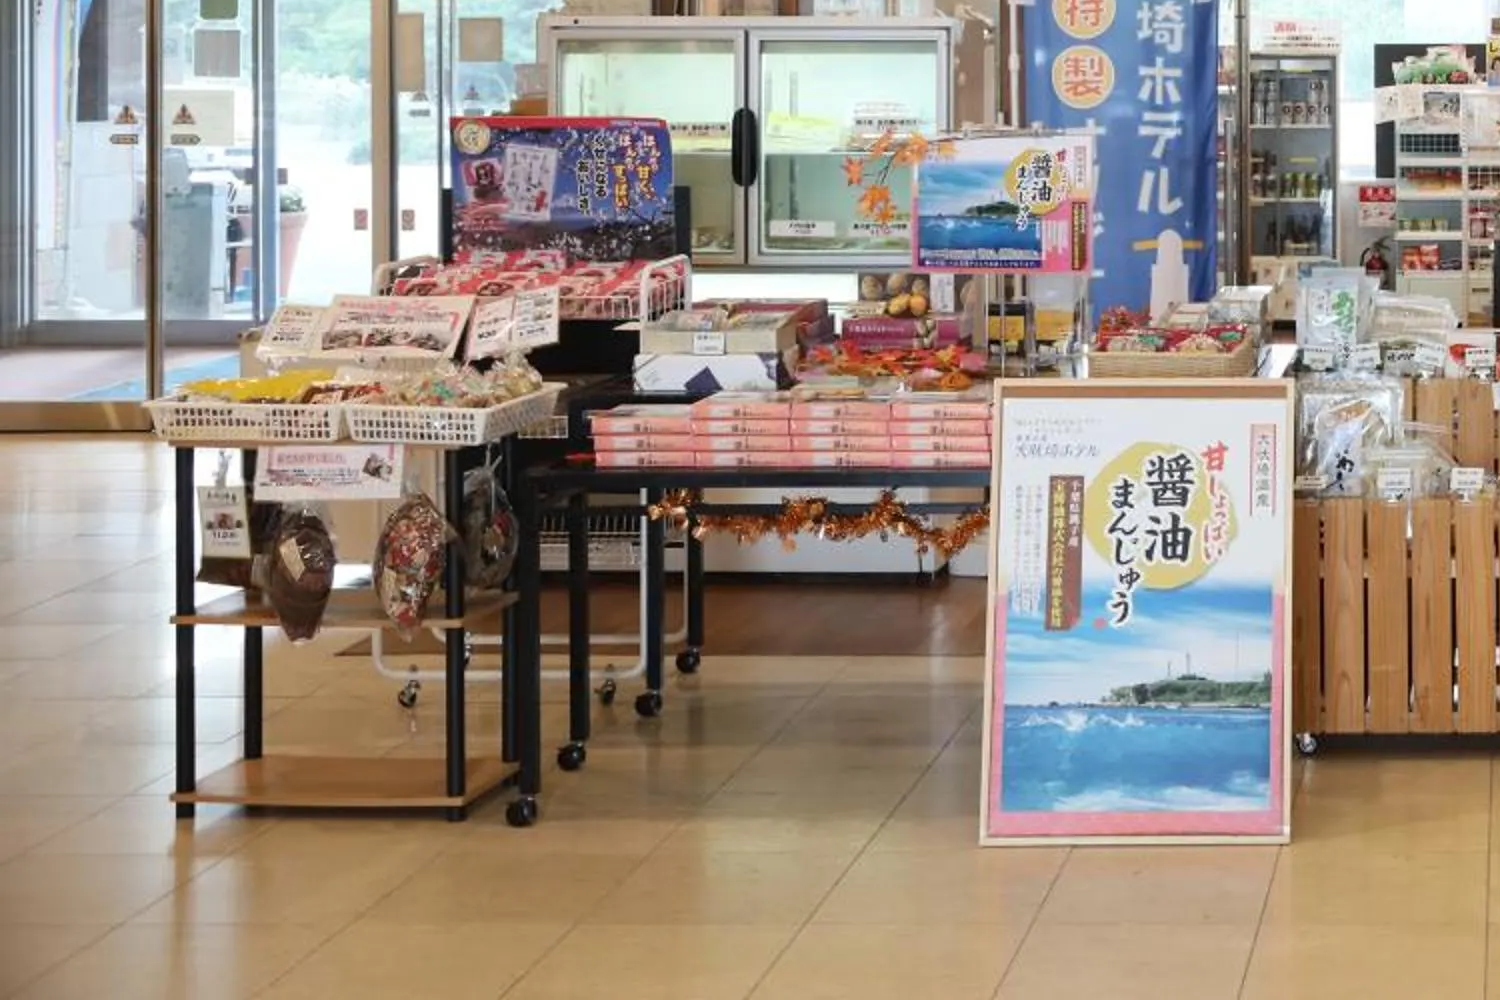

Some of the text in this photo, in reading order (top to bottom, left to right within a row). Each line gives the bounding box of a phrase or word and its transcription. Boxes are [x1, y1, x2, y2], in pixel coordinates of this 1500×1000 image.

[1106, 477, 1141, 624] まんじゅう
[1144, 452, 1195, 563] 醤油
[1203, 441, 1229, 561] 甘しょっぱい
